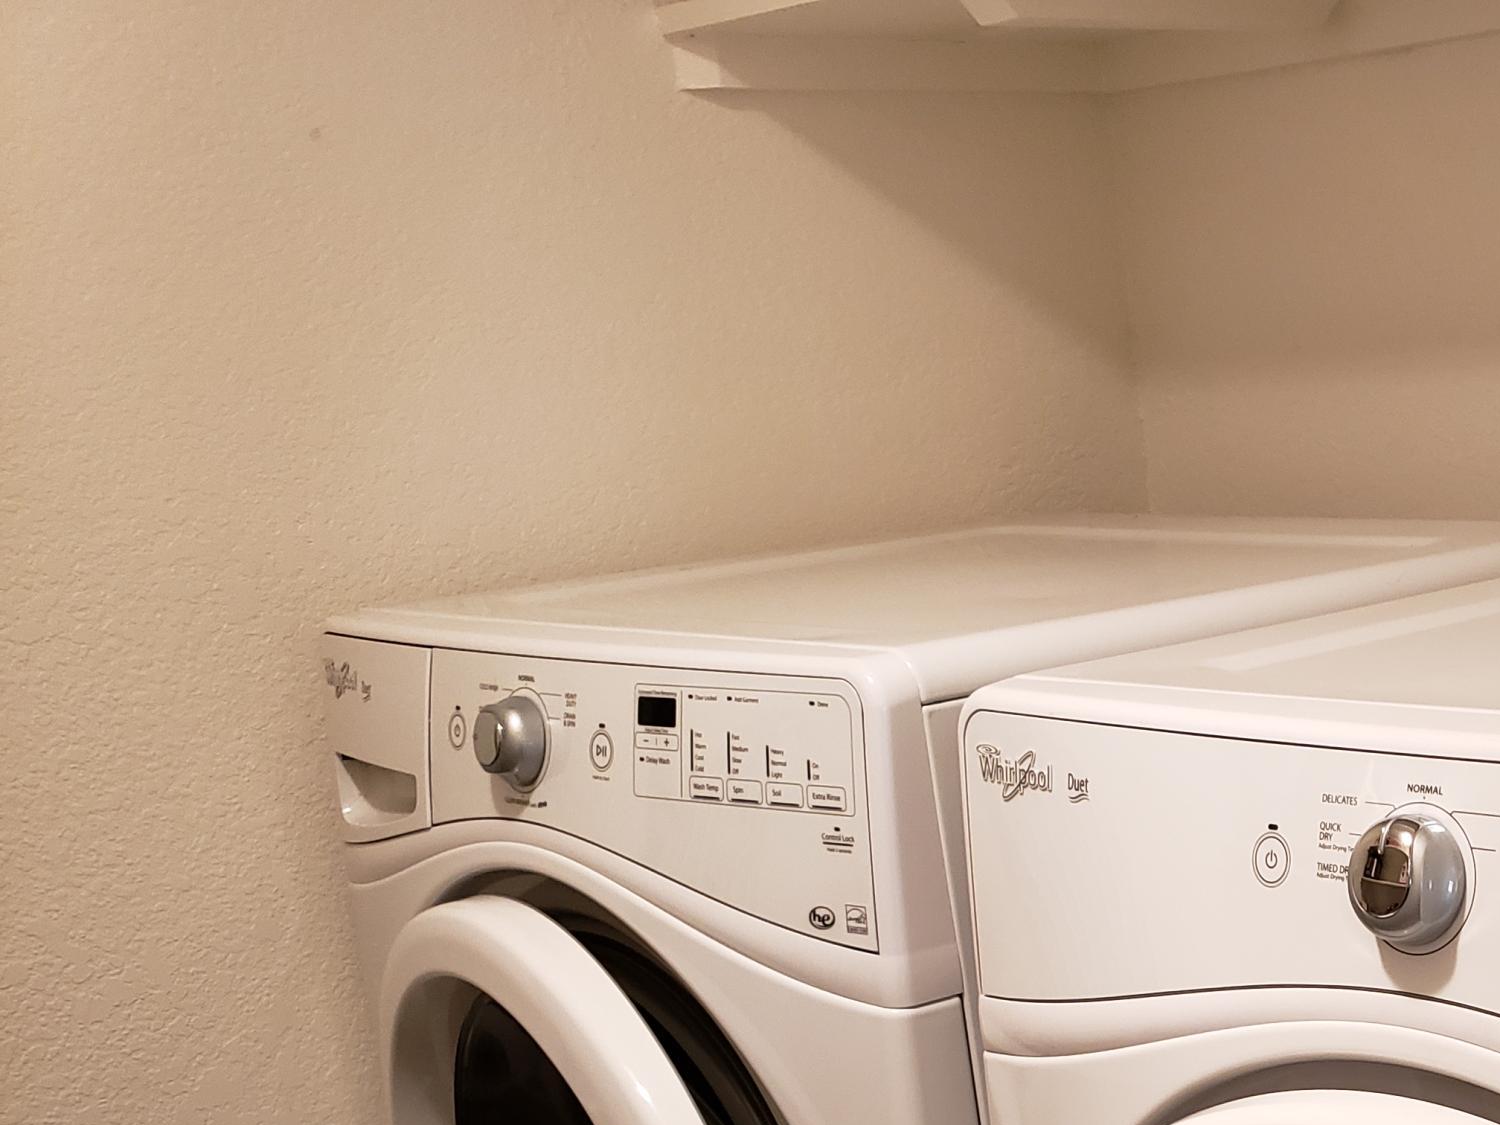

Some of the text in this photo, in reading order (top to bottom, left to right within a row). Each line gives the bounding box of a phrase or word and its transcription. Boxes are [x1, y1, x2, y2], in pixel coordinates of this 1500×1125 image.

[976, 744, 1053, 802] Whirlpool
[1067, 772, 1089, 793] Duet
[732, 785, 744, 794] Spin
[771, 788, 782, 797] Soil
[1407, 783, 1444, 796] NORMAL
[812, 792, 826, 801] Extra
[1321, 793, 1358, 806] DELICATES
[1319, 820, 1342, 832] QUICK
[821, 832, 841, 841] Control
[1319, 831, 1334, 841] DRY
[1332, 844, 1347, 853] Drying
[1317, 862, 1339, 873] TIMED
[1330, 874, 1345, 882] Drying
